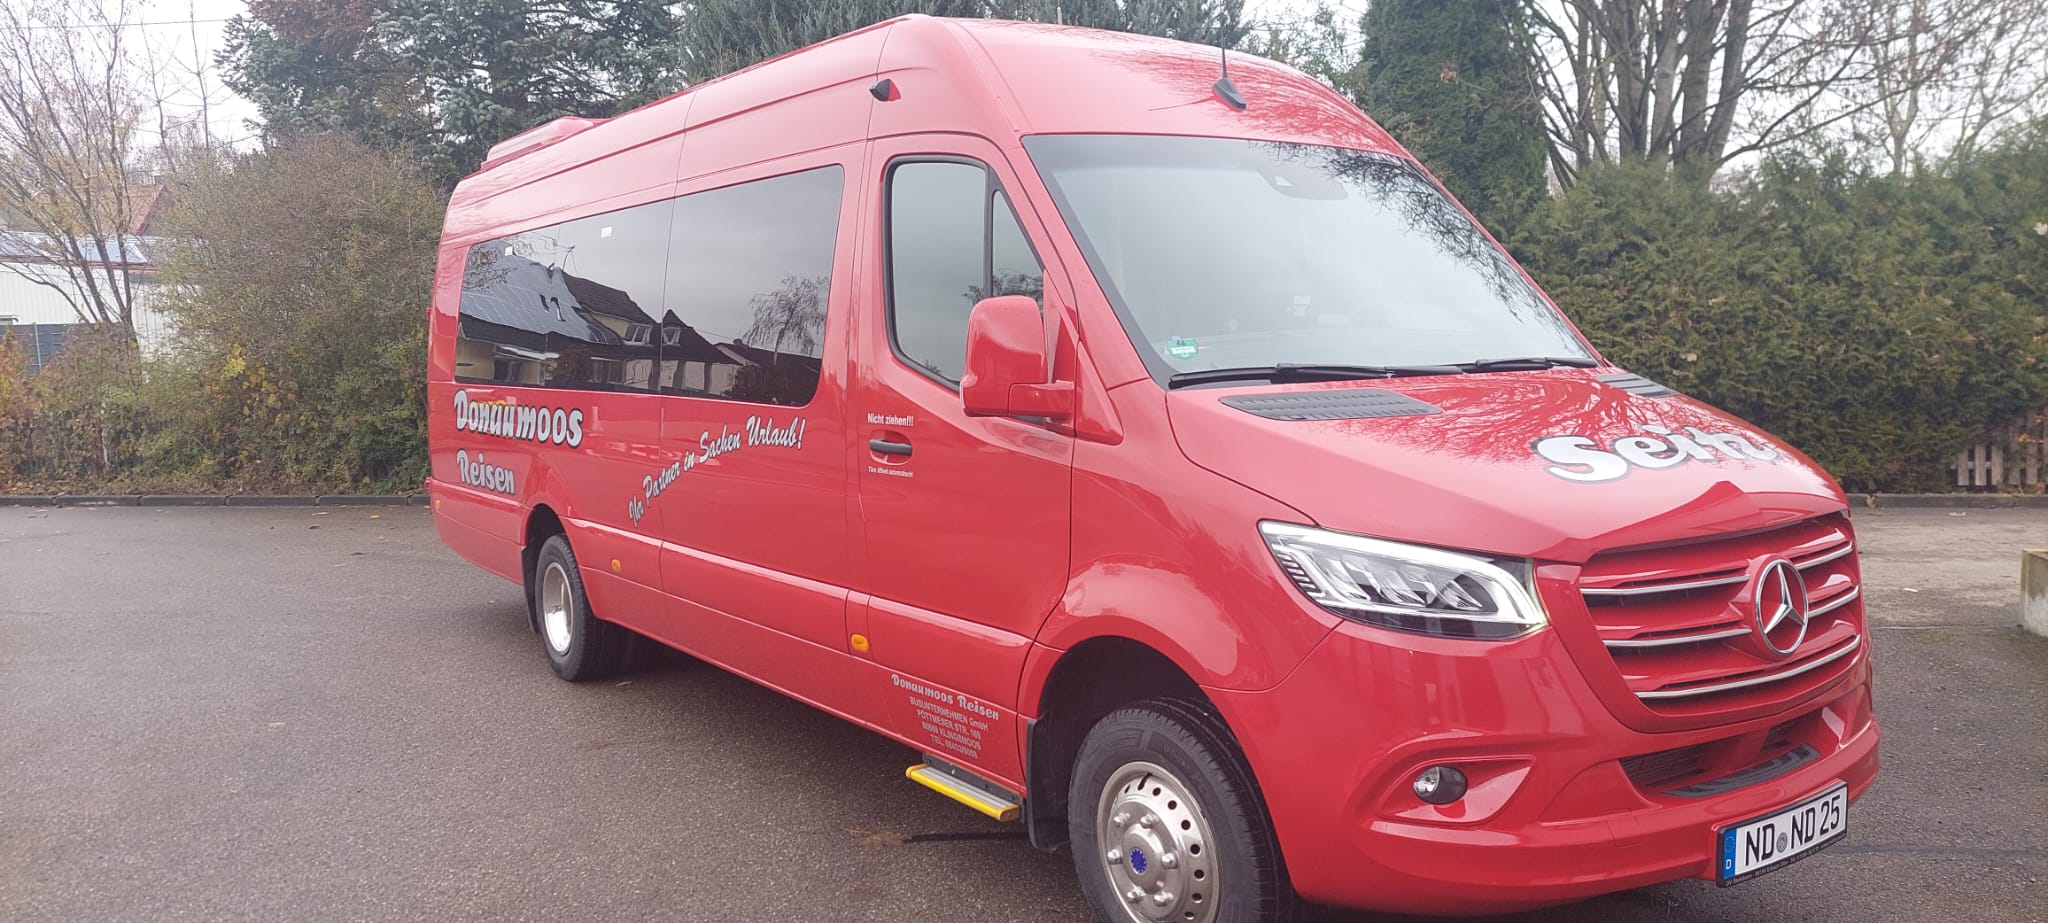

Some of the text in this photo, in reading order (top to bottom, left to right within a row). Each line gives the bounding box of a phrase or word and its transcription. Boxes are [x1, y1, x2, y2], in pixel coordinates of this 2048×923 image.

[454, 388, 584, 448] Donaumoos
[867, 411, 885, 424] Nicht
[456, 448, 516, 495] Reisen
[643, 460, 681, 507] Partner
[683, 450, 696, 471] in
[699, 424, 742, 463] Sachen
[746, 415, 806, 450] Urlaub!
[891, 673, 999, 720] Donaumoos Reisen
[968, 717, 989, 732] GmbH
[1745, 823, 1775, 866] ND
[1791, 807, 1816, 849] ND
[1819, 795, 1841, 836] 25
[1725, 859, 1732, 870] D
